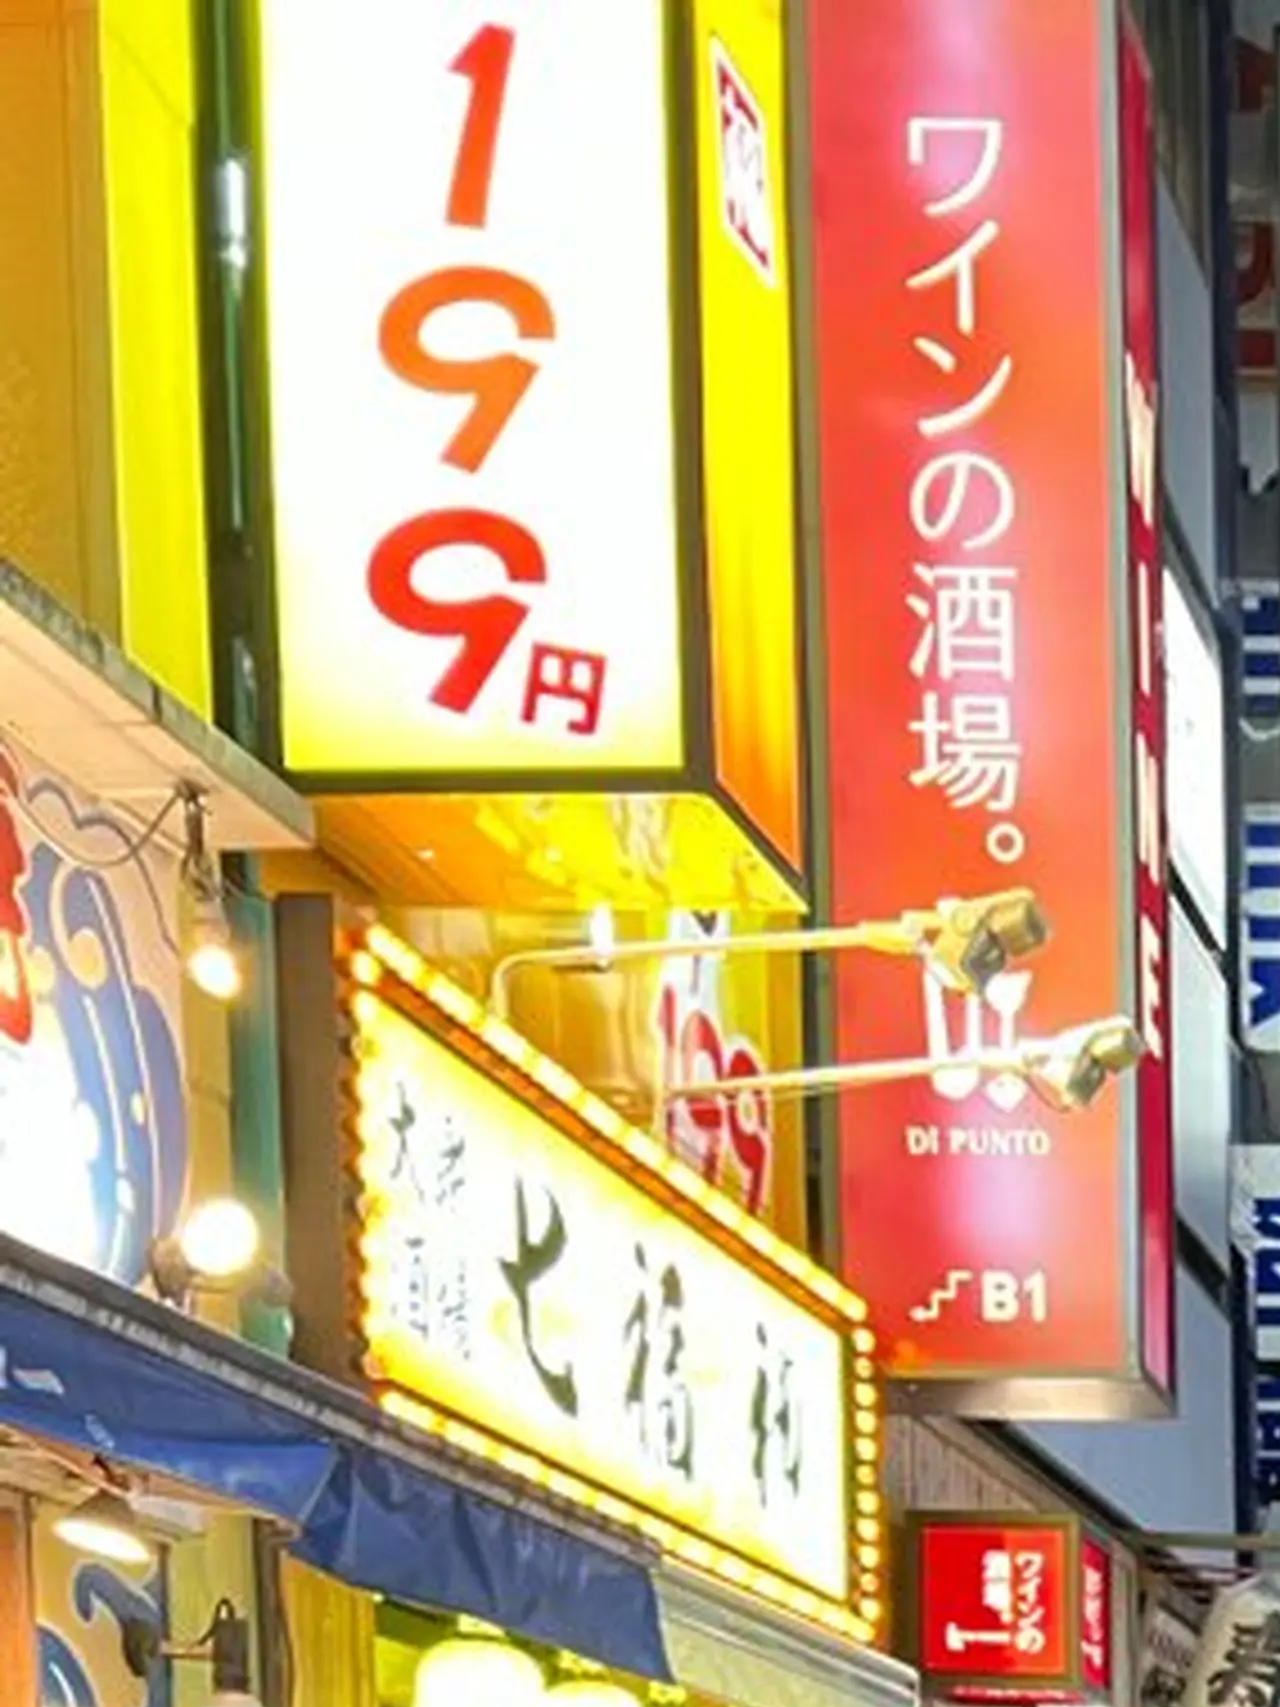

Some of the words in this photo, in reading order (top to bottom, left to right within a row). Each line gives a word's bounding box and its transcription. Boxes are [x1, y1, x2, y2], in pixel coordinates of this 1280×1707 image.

[366, 23, 607, 735] 199円
[905, 115, 1025, 865] ワインの酒場。
[949, 1127, 1051, 1156] PUNTO
[981, 1270, 1048, 1322] B1
